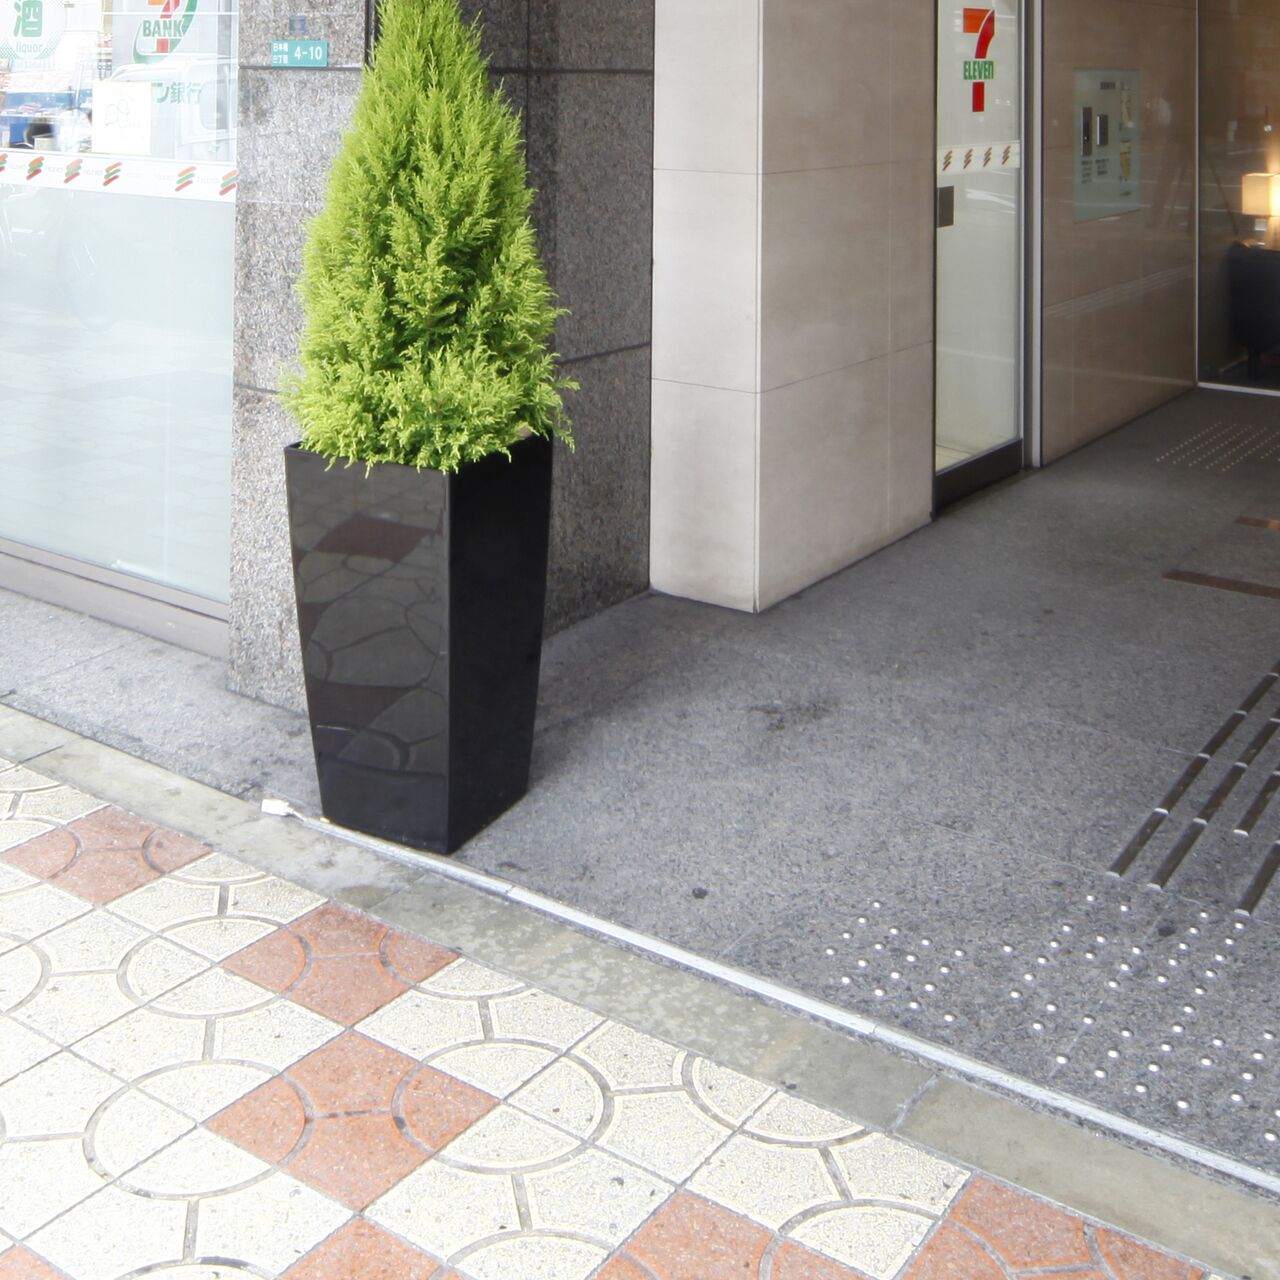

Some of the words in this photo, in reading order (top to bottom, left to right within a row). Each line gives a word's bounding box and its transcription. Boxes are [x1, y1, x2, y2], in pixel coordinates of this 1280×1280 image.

[143, 20, 184, 38] BANK
[16, 41, 43, 54] liquor
[294, 46, 322, 60] 4-10
